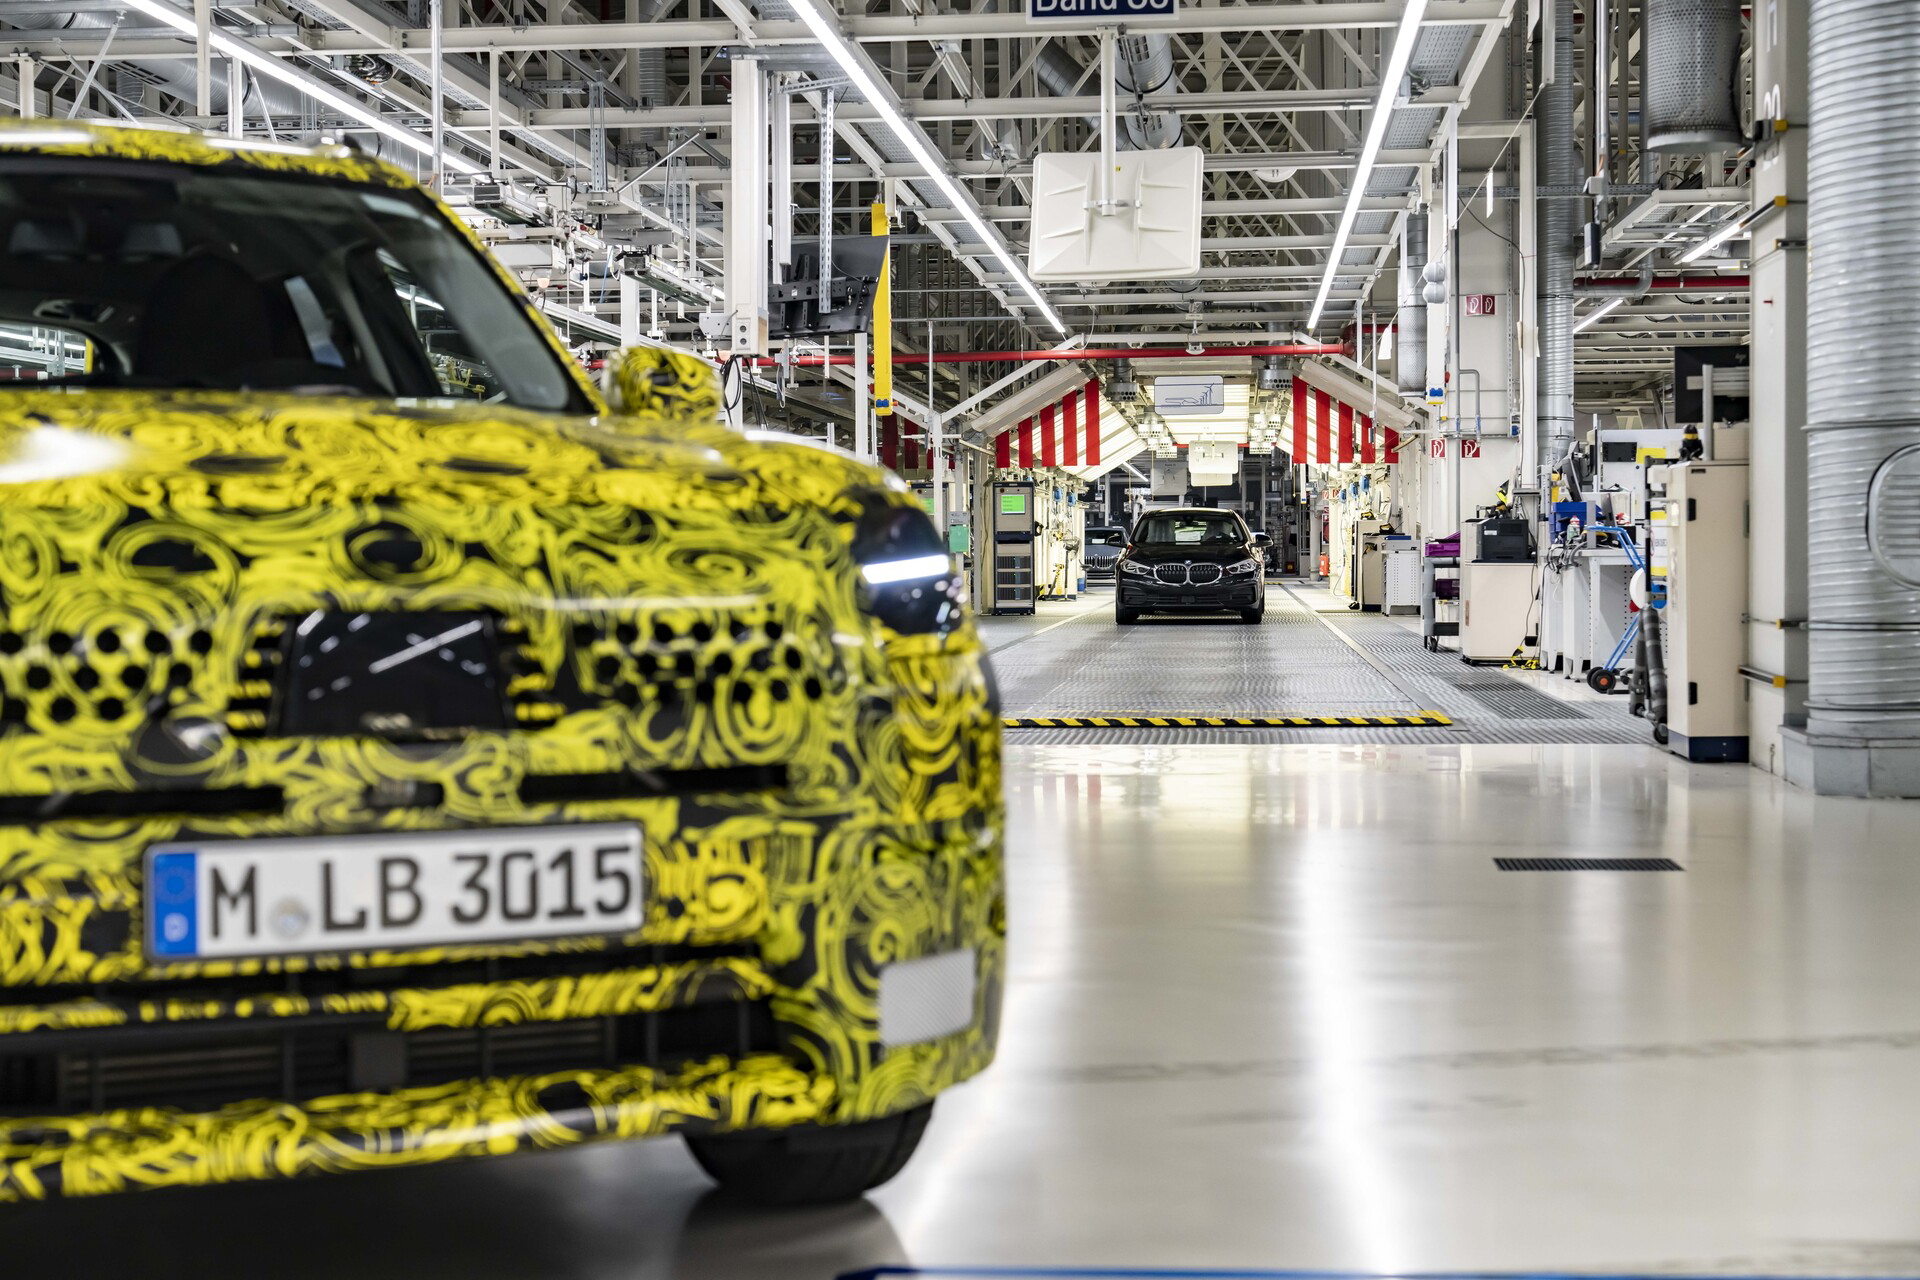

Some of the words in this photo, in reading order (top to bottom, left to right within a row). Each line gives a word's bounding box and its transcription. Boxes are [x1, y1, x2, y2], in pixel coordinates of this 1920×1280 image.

[210, 864, 257, 939] M
[323, 857, 424, 931] LB
[452, 846, 631, 924] 3015
